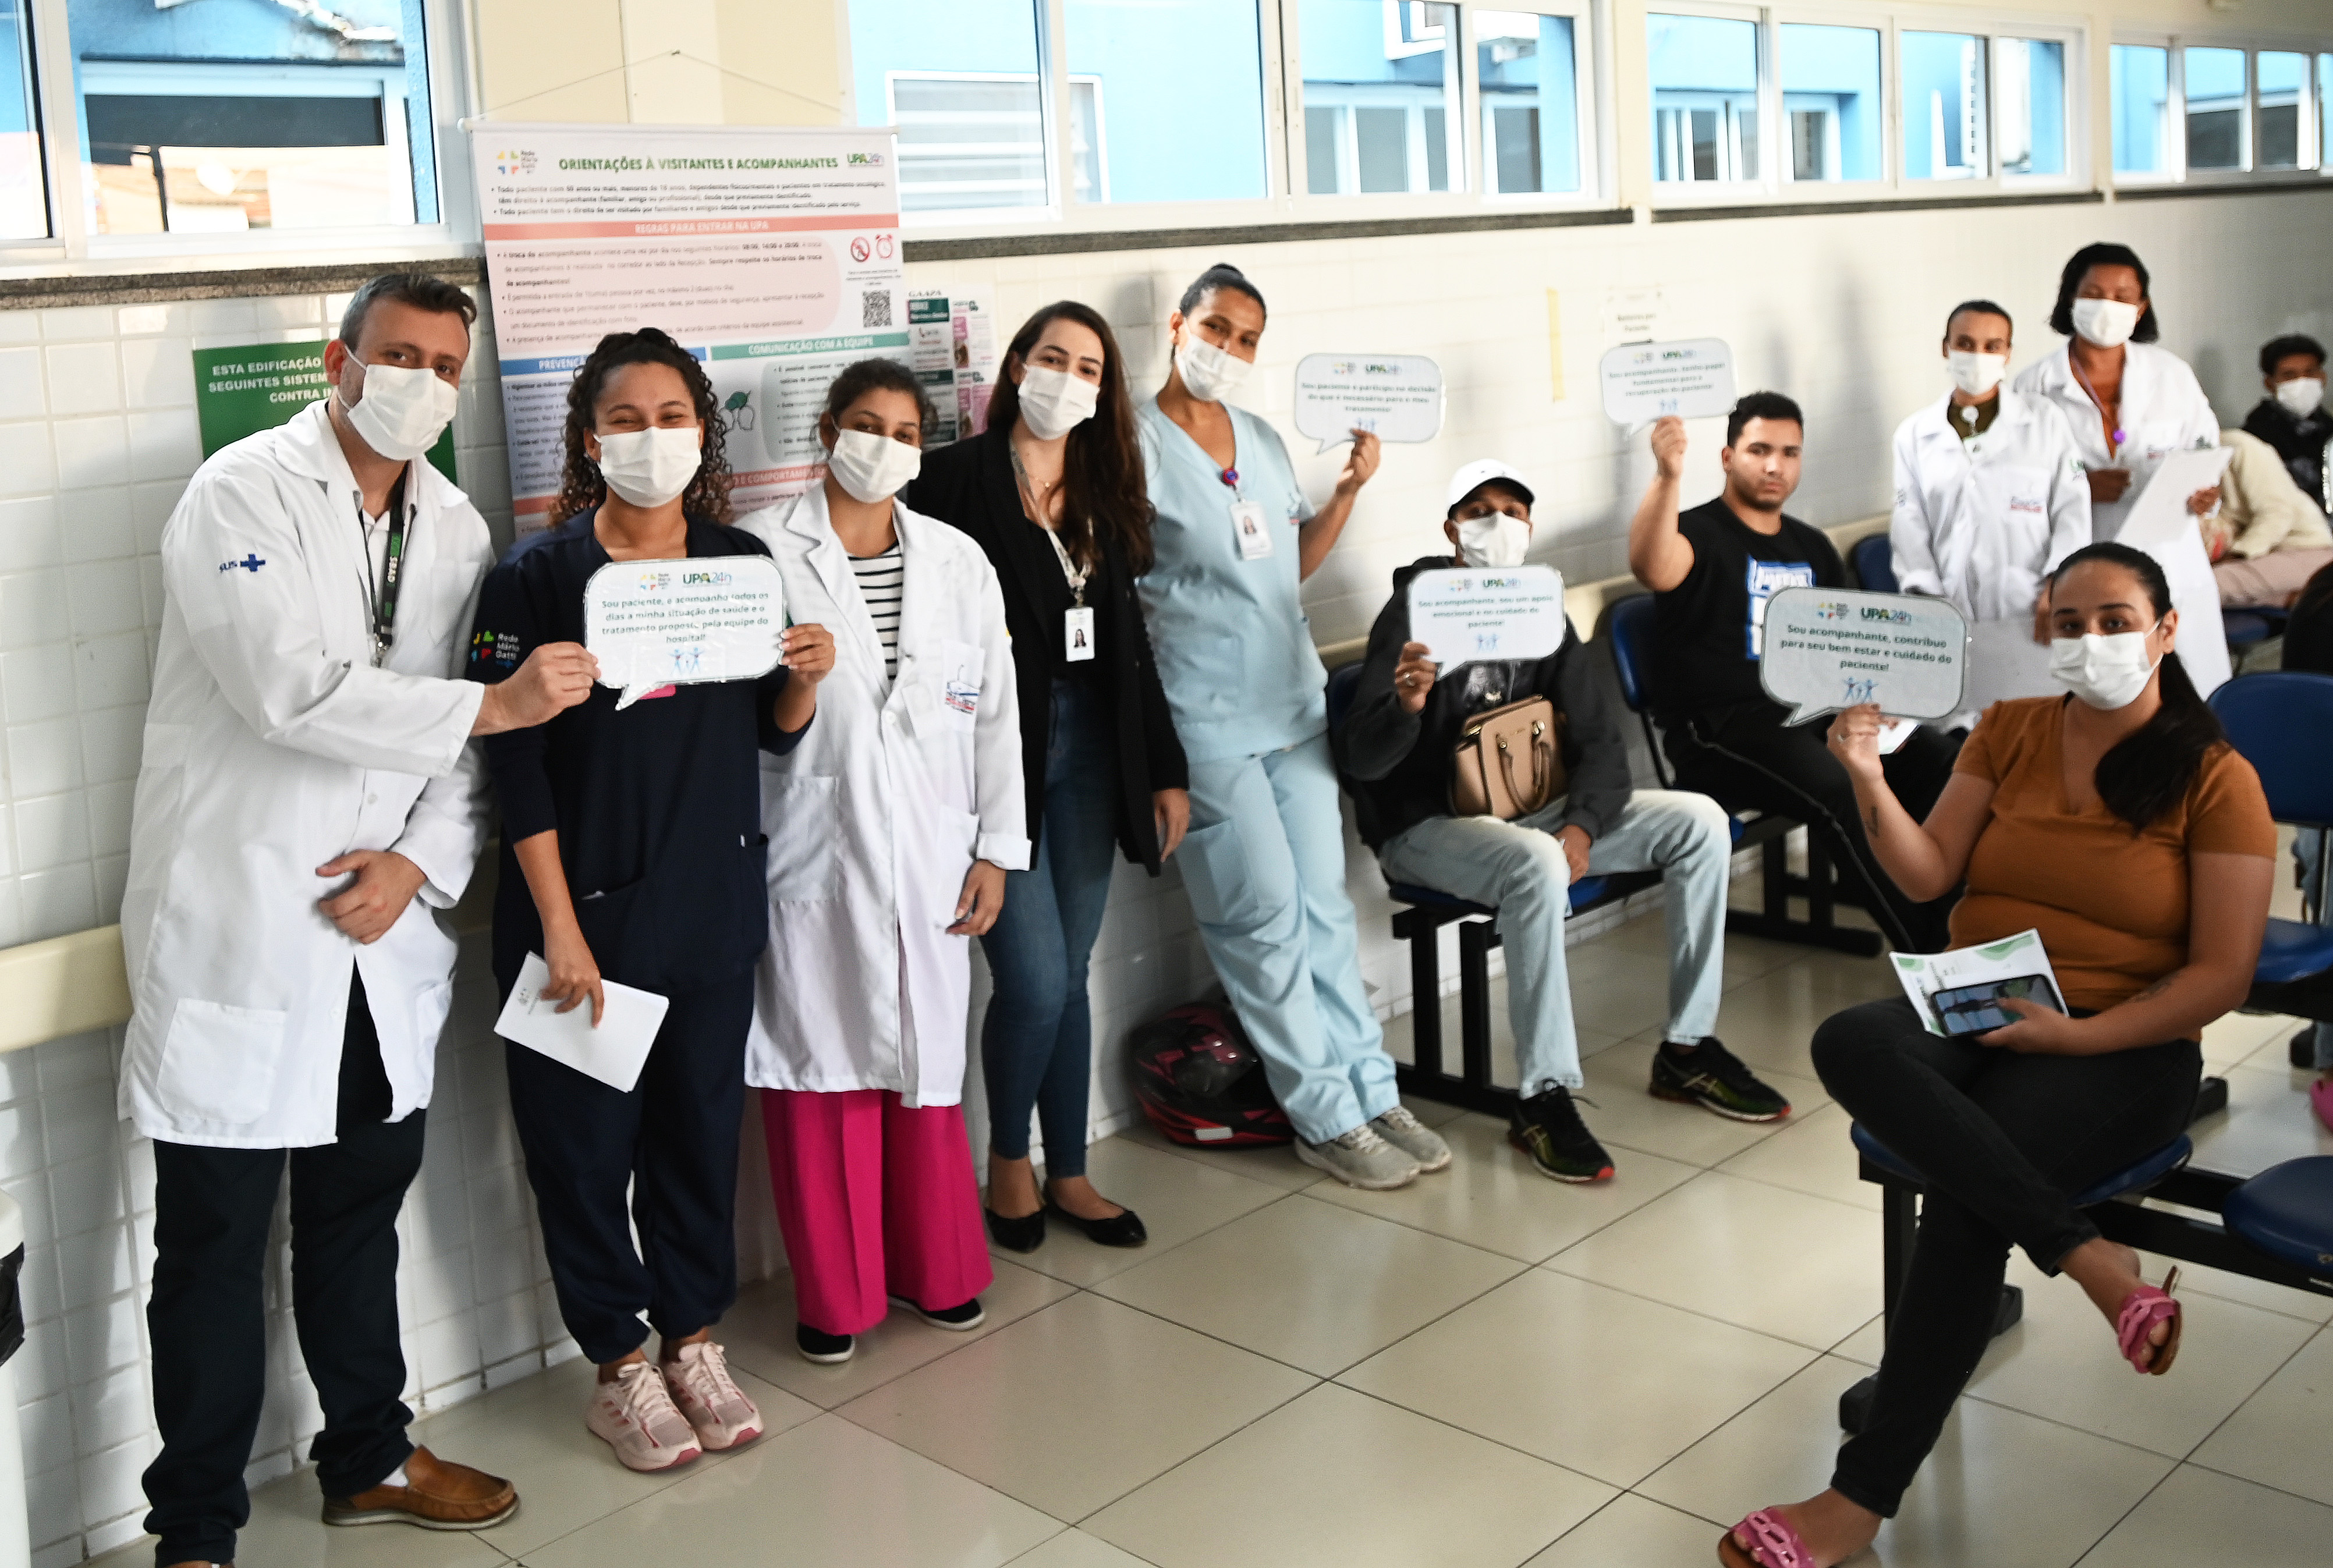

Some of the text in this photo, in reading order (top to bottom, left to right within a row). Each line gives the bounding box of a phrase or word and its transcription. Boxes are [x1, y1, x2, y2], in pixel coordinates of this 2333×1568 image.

[558, 155, 641, 173] ORIENTAÇÕES
[658, 157, 724, 171] VISITANTES
[736, 156, 838, 169] ACOMPANHANTES
[212, 356, 321, 376] ESTA EDIFICAÇÃO
[208, 371, 328, 393] SEGUINTES SISTEM
[269, 389, 320, 403] CONTRA
[602, 600, 619, 608] Sou
[605, 613, 625, 622] dias
[636, 609, 665, 619] minha
[668, 607, 706, 618] situação
[708, 606, 720, 615] de
[602, 623, 656, 634] tratamento
[702, 620, 721, 629] pela
[724, 618, 754, 629] equipe
[757, 616, 768, 625] do
[1788, 624, 1806, 634] Sou
[1809, 627, 1891, 644] acompanhante,
[1781, 639, 1805, 650] para
[1807, 642, 1825, 651] seu
[1828, 643, 1852, 654] bem
[1854, 646, 1881, 657] estar
[1893, 649, 1935, 662] cuidado
[1938, 654, 1952, 664] do
[1839, 659, 1889, 672] paciente!
